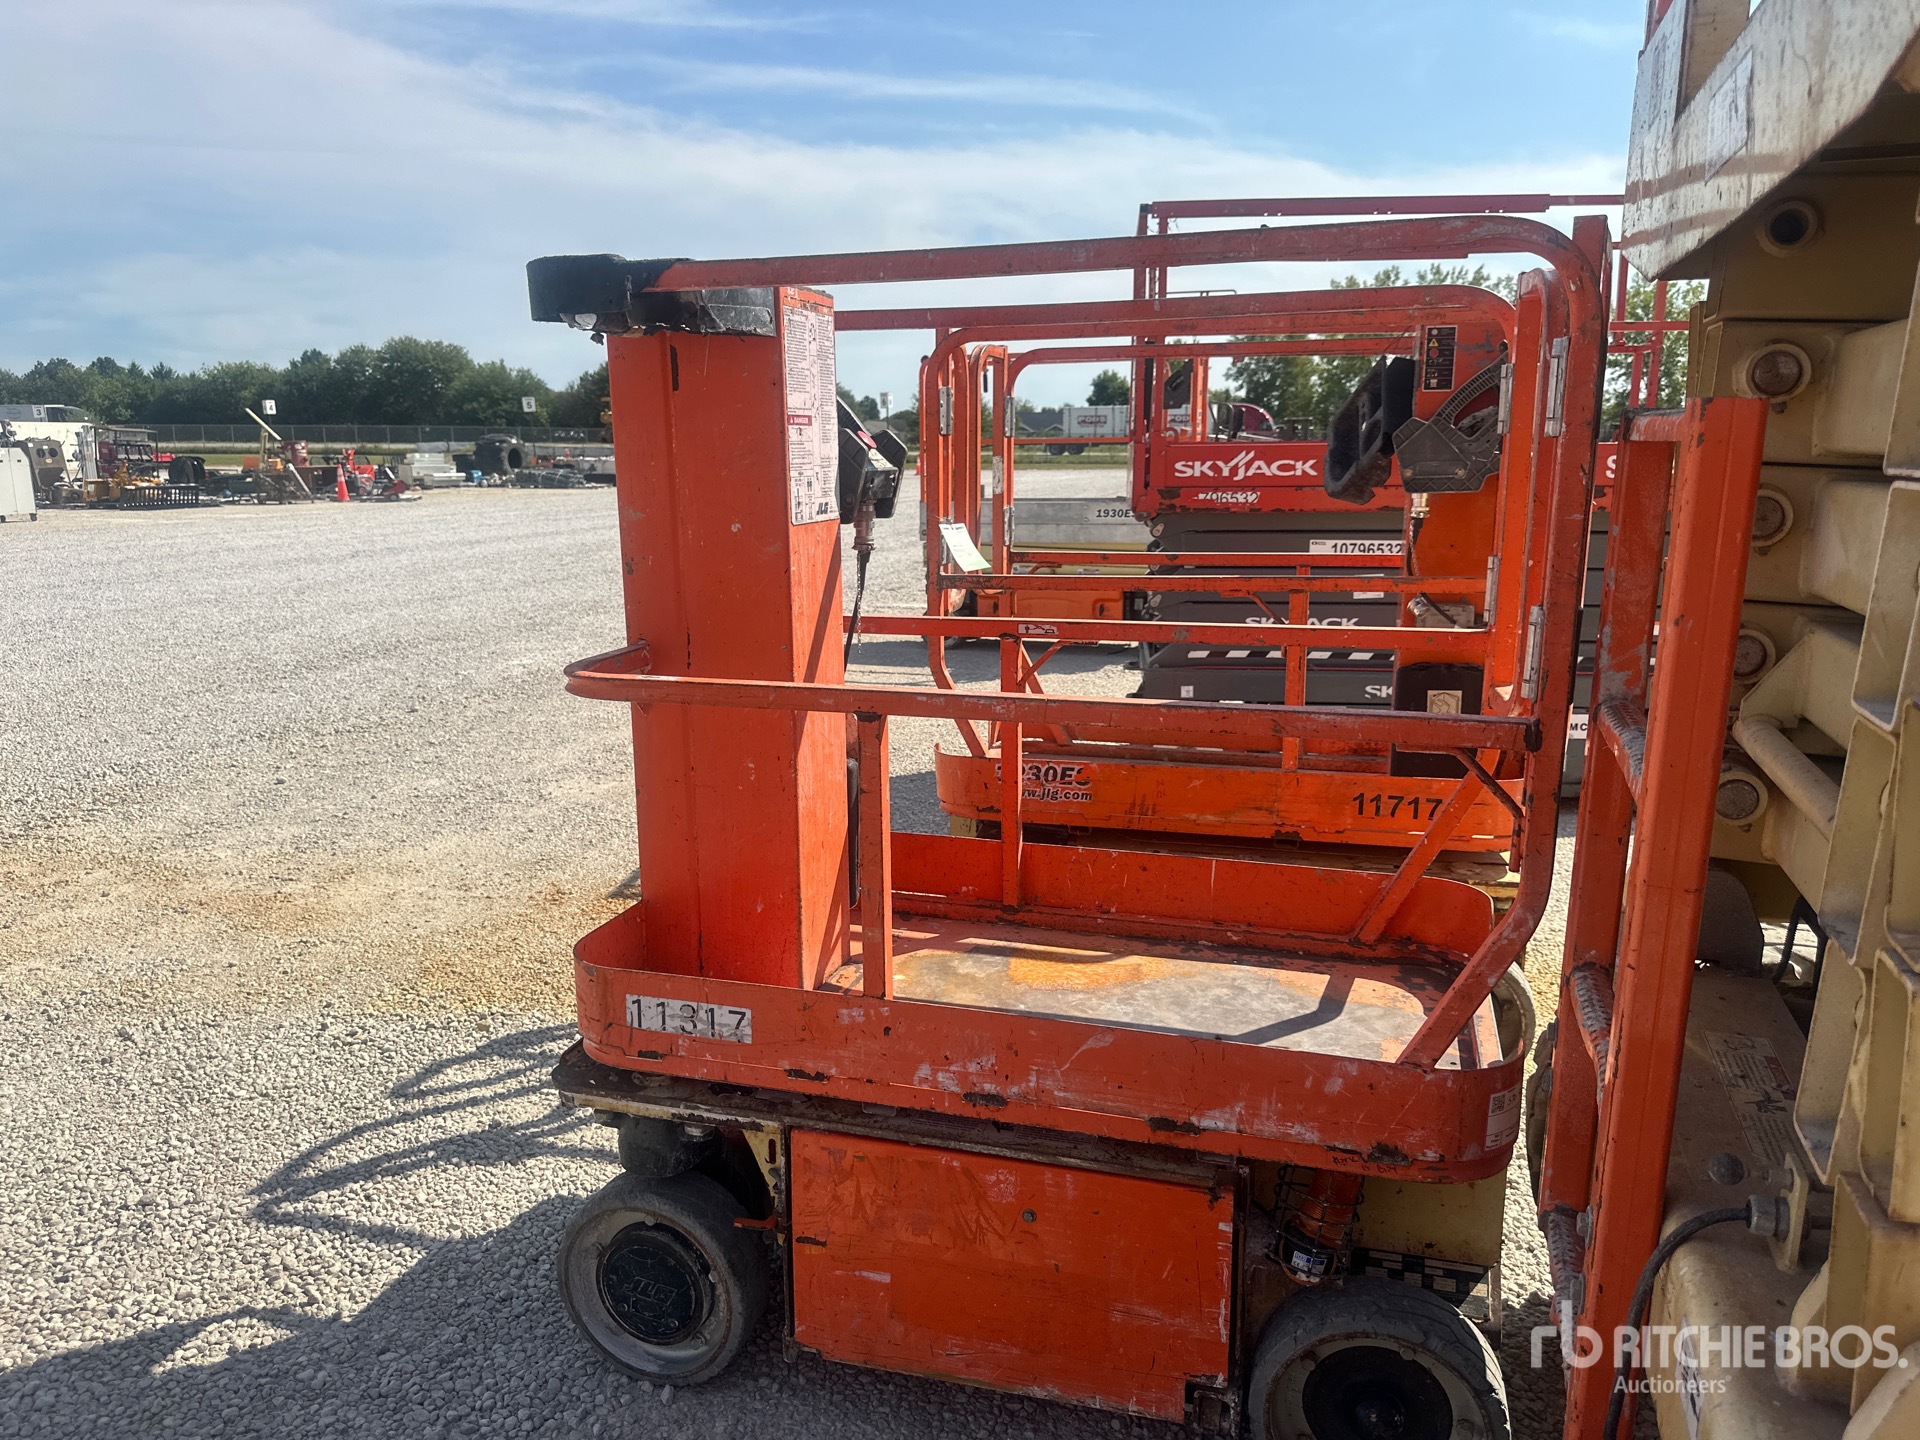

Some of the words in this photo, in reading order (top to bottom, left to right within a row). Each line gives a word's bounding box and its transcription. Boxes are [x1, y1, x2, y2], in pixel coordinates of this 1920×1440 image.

[526, 401, 533, 409] 5
[36, 408, 42, 416] 3
[1078, 415, 1106, 424] PODS
[1169, 414, 1190, 424] POD
[1174, 450, 1318, 480] SKYJACK
[816, 501, 829, 515] JLG
[1096, 508, 1135, 518] 1930E
[1331, 542, 1402, 554] 10796532
[1352, 792, 1443, 821] 11717
[631, 998, 746, 1043] 11317
